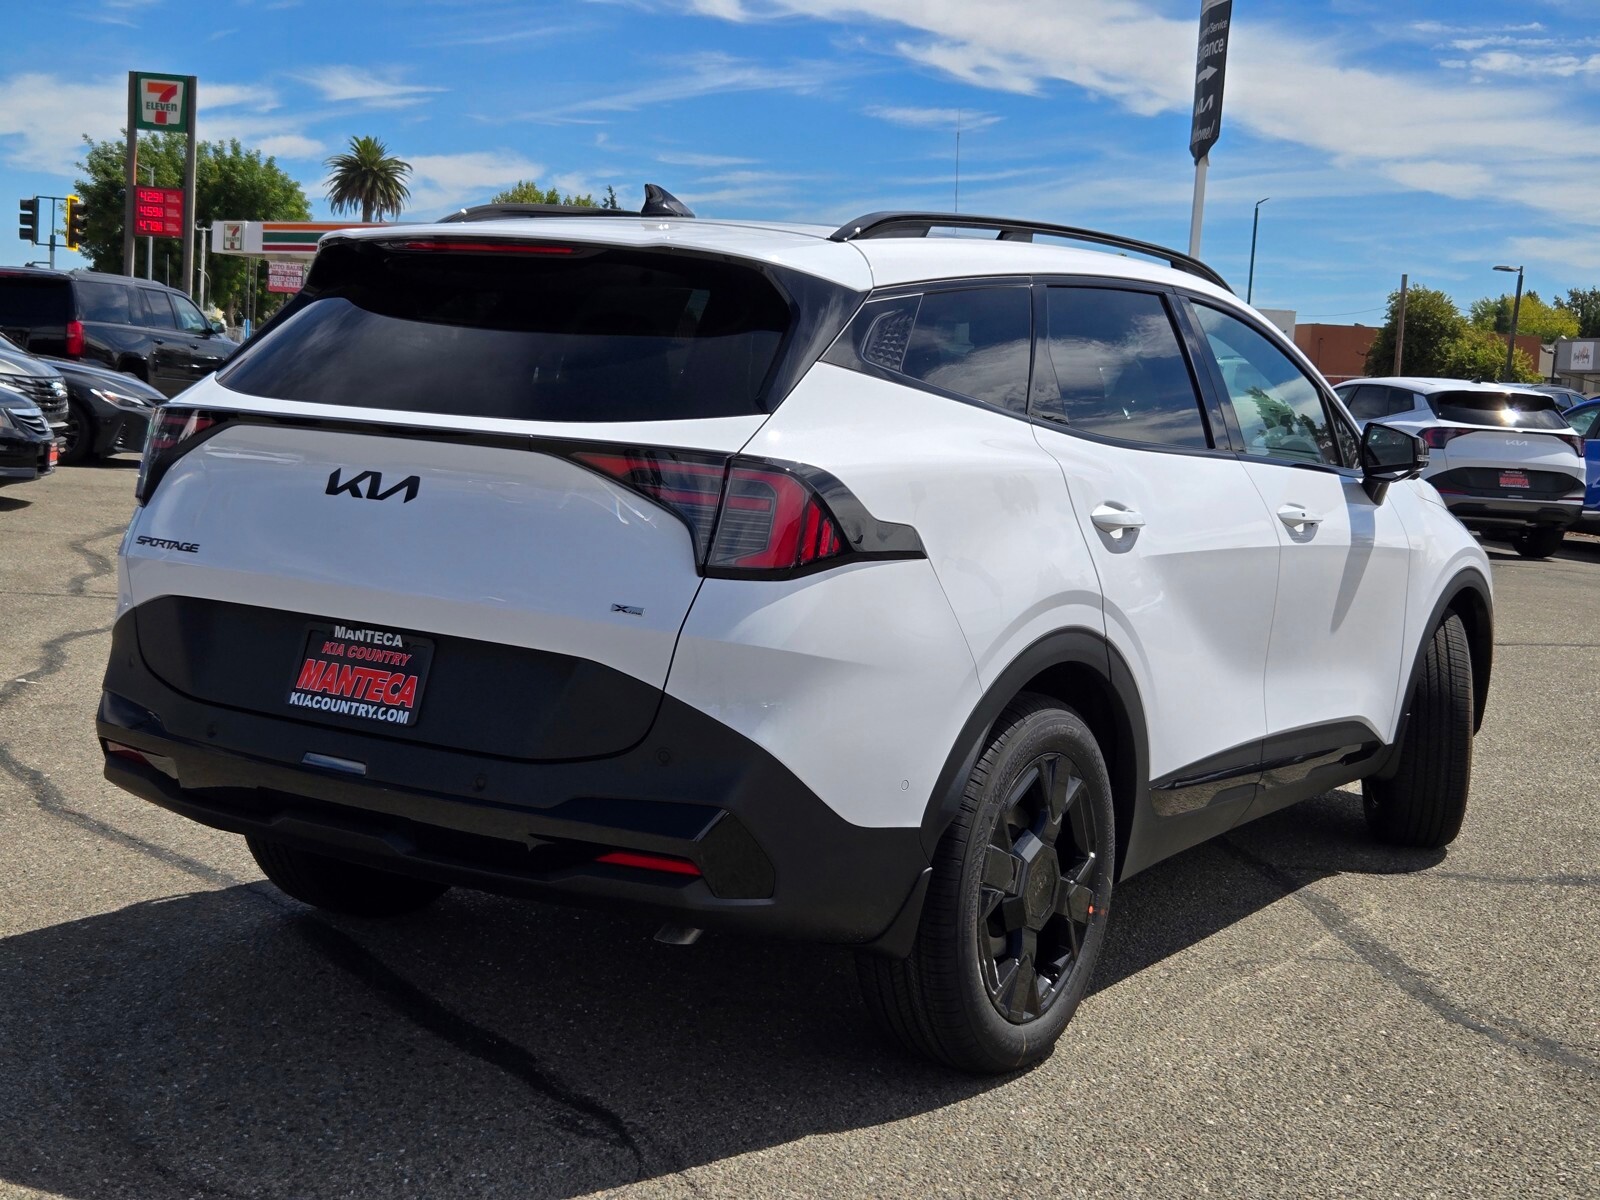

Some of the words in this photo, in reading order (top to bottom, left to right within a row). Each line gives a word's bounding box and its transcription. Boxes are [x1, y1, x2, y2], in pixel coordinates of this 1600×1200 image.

[146, 101, 178, 112] ELEVEN
[325, 467, 421, 504] KIA
[135, 535, 200, 553] SPORTAGE
[334, 625, 403, 648] MANTECA
[321, 641, 345, 657] KIA
[347, 645, 412, 667] COUNTRY
[295, 658, 418, 709] MANTECA
[289, 691, 410, 725] KIACOUNTRY.COM
